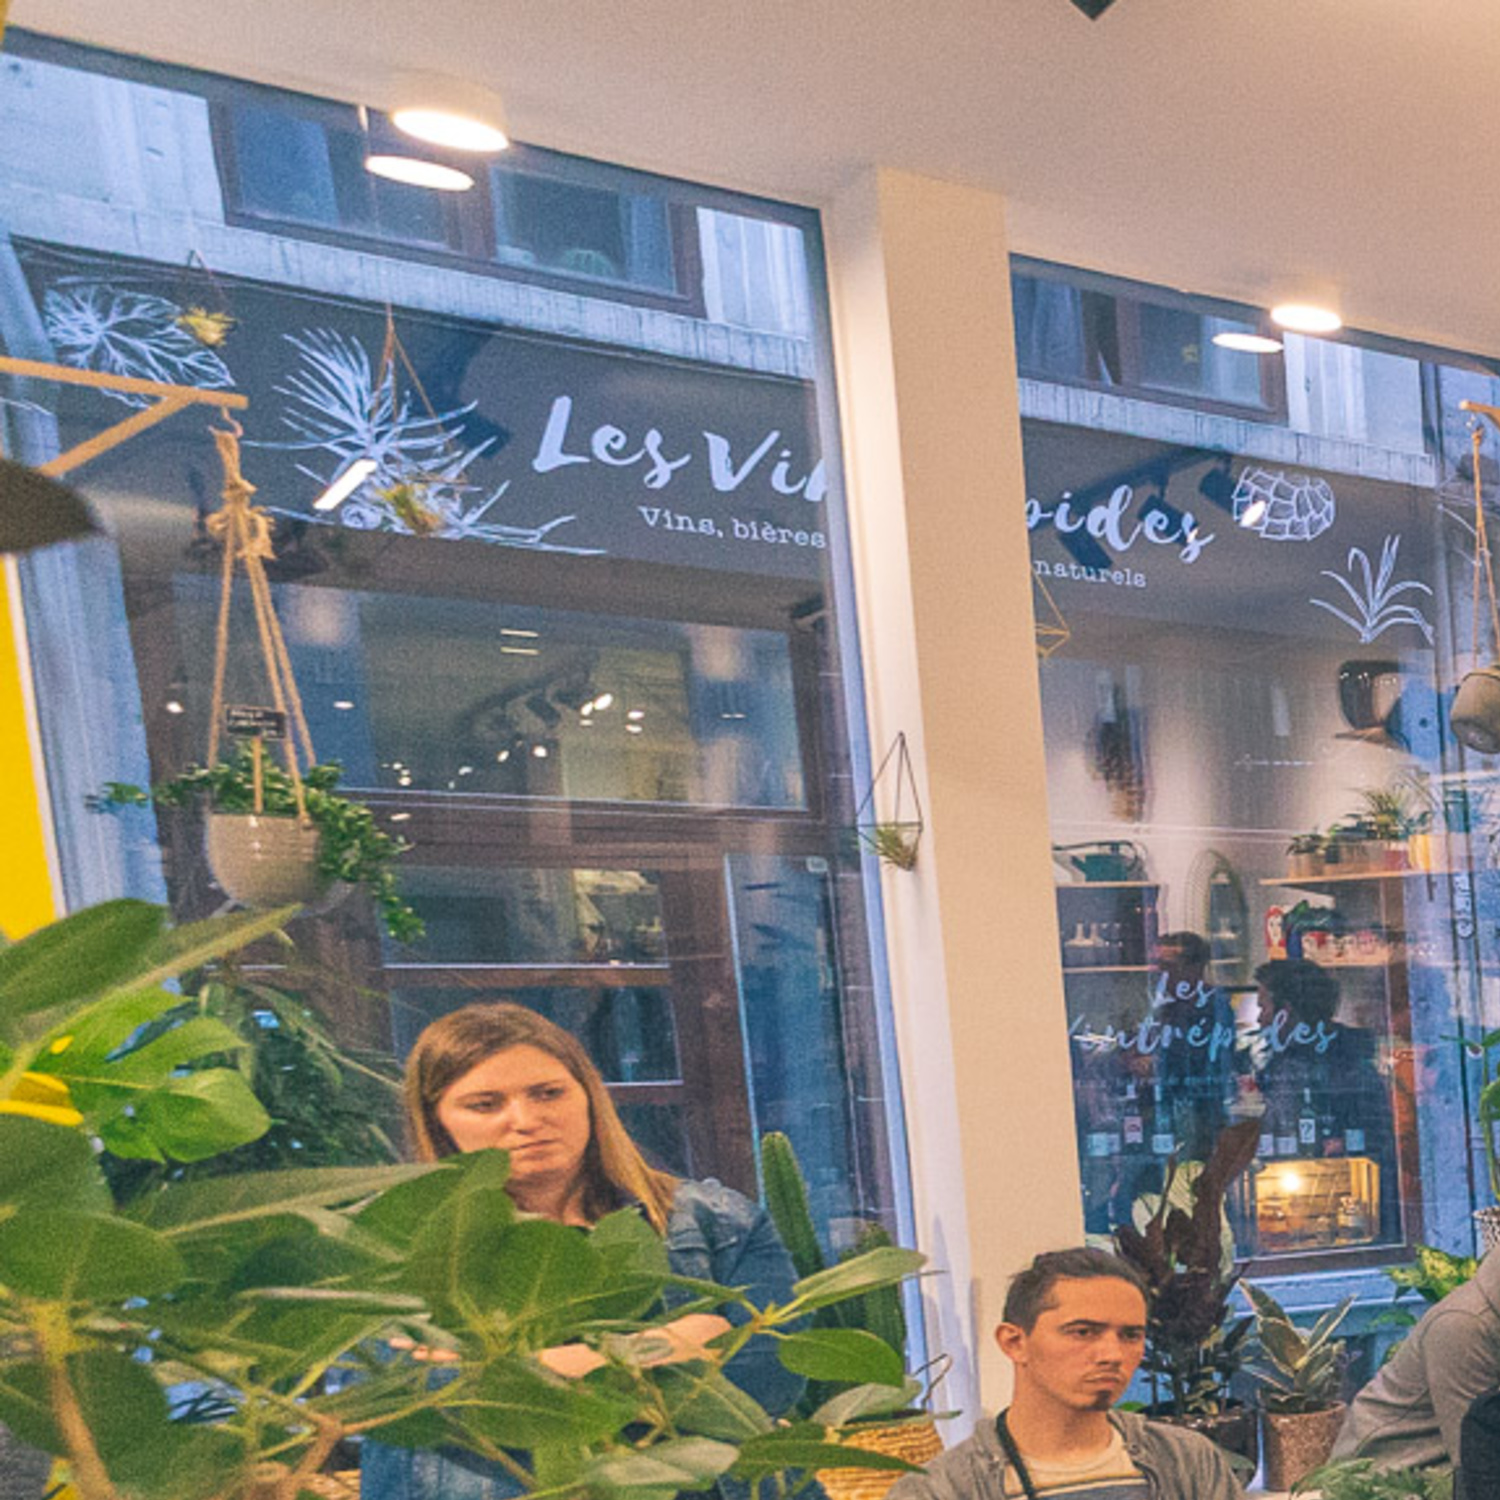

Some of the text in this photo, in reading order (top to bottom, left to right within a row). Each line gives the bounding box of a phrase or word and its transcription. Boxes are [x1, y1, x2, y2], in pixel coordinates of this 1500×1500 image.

[532, 395, 692, 489] Les
[637, 505, 1147, 588] Vins, bières naturels
[1152, 970, 1217, 1009] Les
